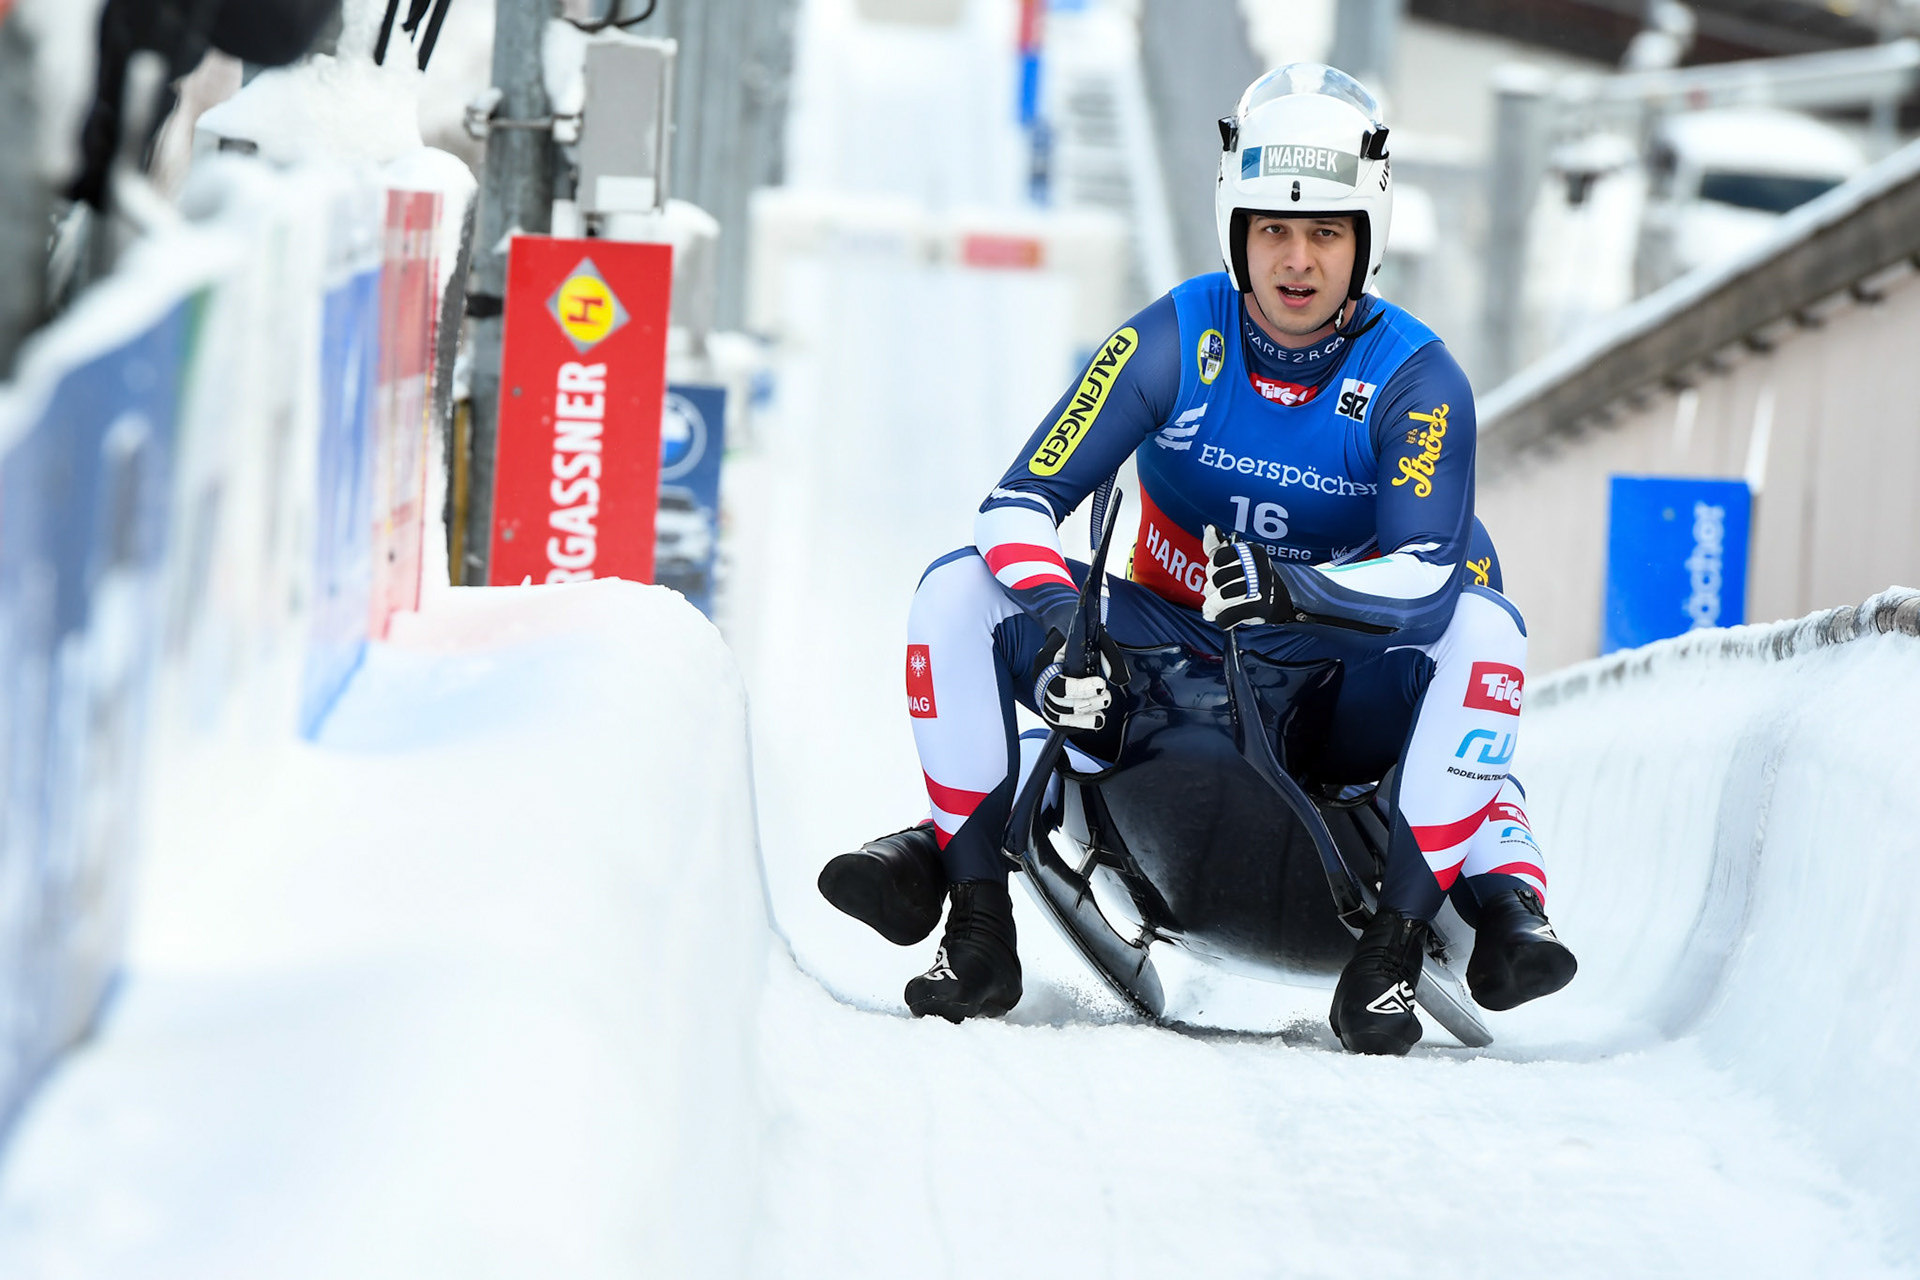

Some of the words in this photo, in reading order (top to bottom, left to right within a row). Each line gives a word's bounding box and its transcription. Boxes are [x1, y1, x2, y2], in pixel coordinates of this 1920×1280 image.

[1268, 146, 1339, 173] WARBEK
[1034, 334, 1132, 467] PALFINGER
[545, 361, 607, 583] RGASSNER
[1198, 443, 1377, 497] Eberspächer
[1391, 403, 1450, 498] Ströck
[1229, 495, 1289, 540] 16
[1146, 522, 1205, 593] HARG
[1257, 543, 1312, 560] BERG
[1481, 673, 1524, 710] Tiro
